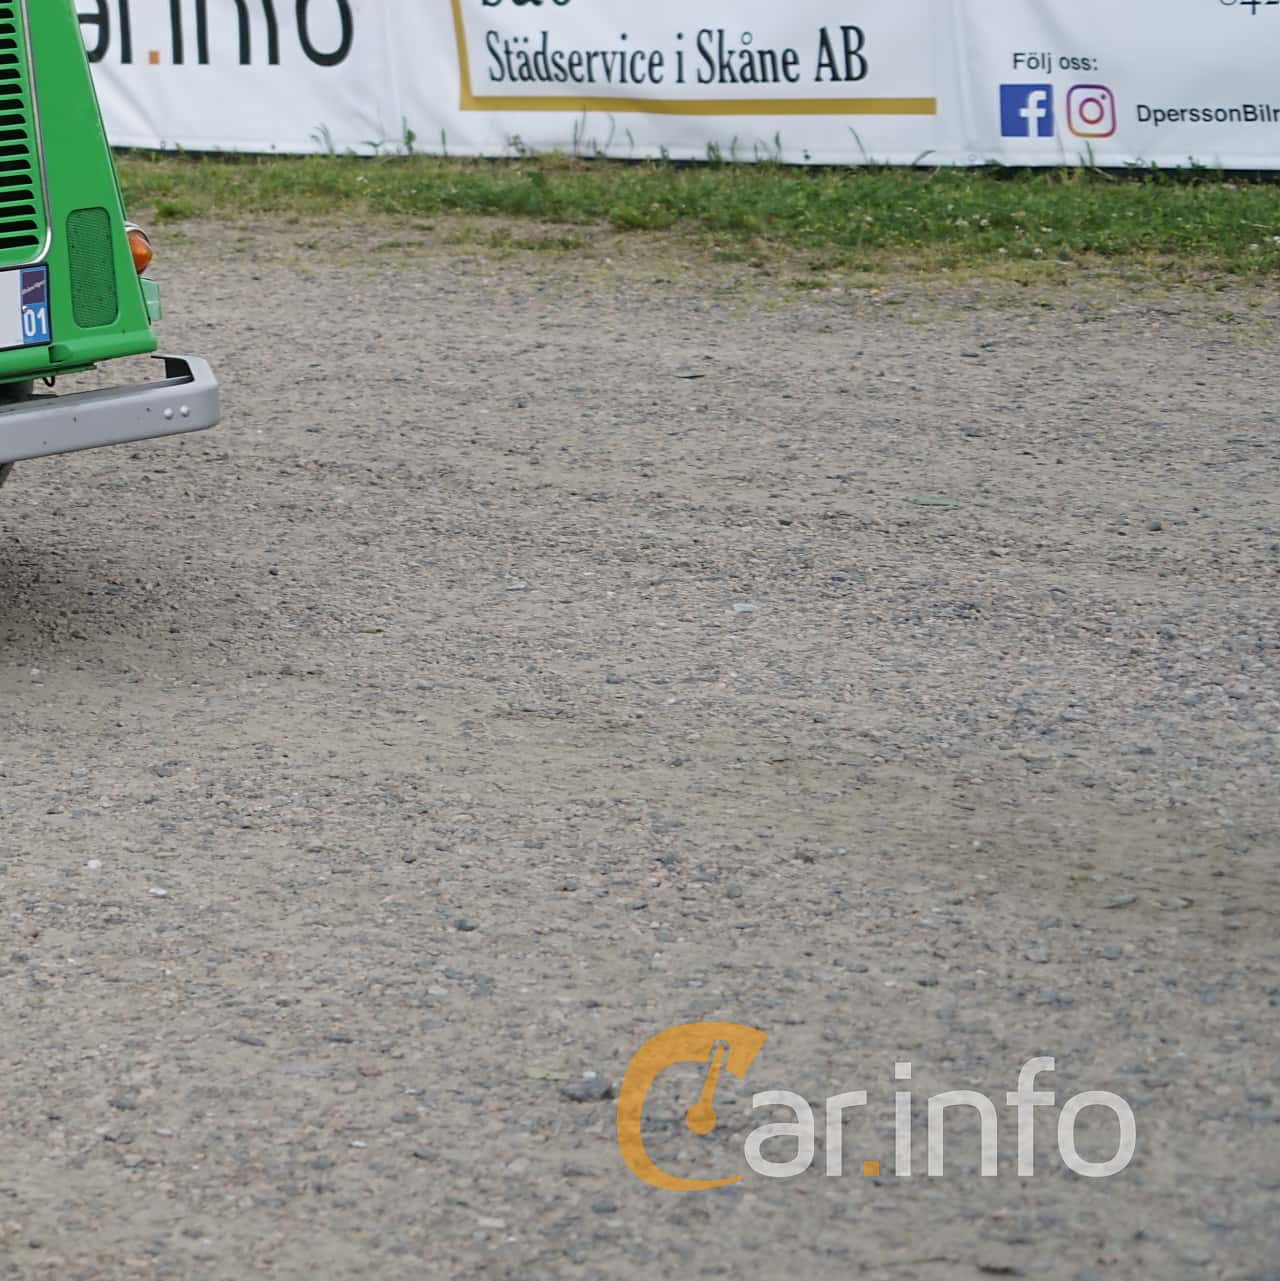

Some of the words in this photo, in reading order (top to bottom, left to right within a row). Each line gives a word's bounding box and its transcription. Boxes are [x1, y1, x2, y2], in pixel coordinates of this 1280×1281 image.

[486, 30, 664, 84] Städservice
[675, 32, 686, 84] i
[696, 28, 801, 84] Skåne
[813, 25, 869, 83] AB
[1013, 52, 1052, 74] Följ
[1059, 55, 1098, 71] oss:
[23, 307, 48, 337] 01
